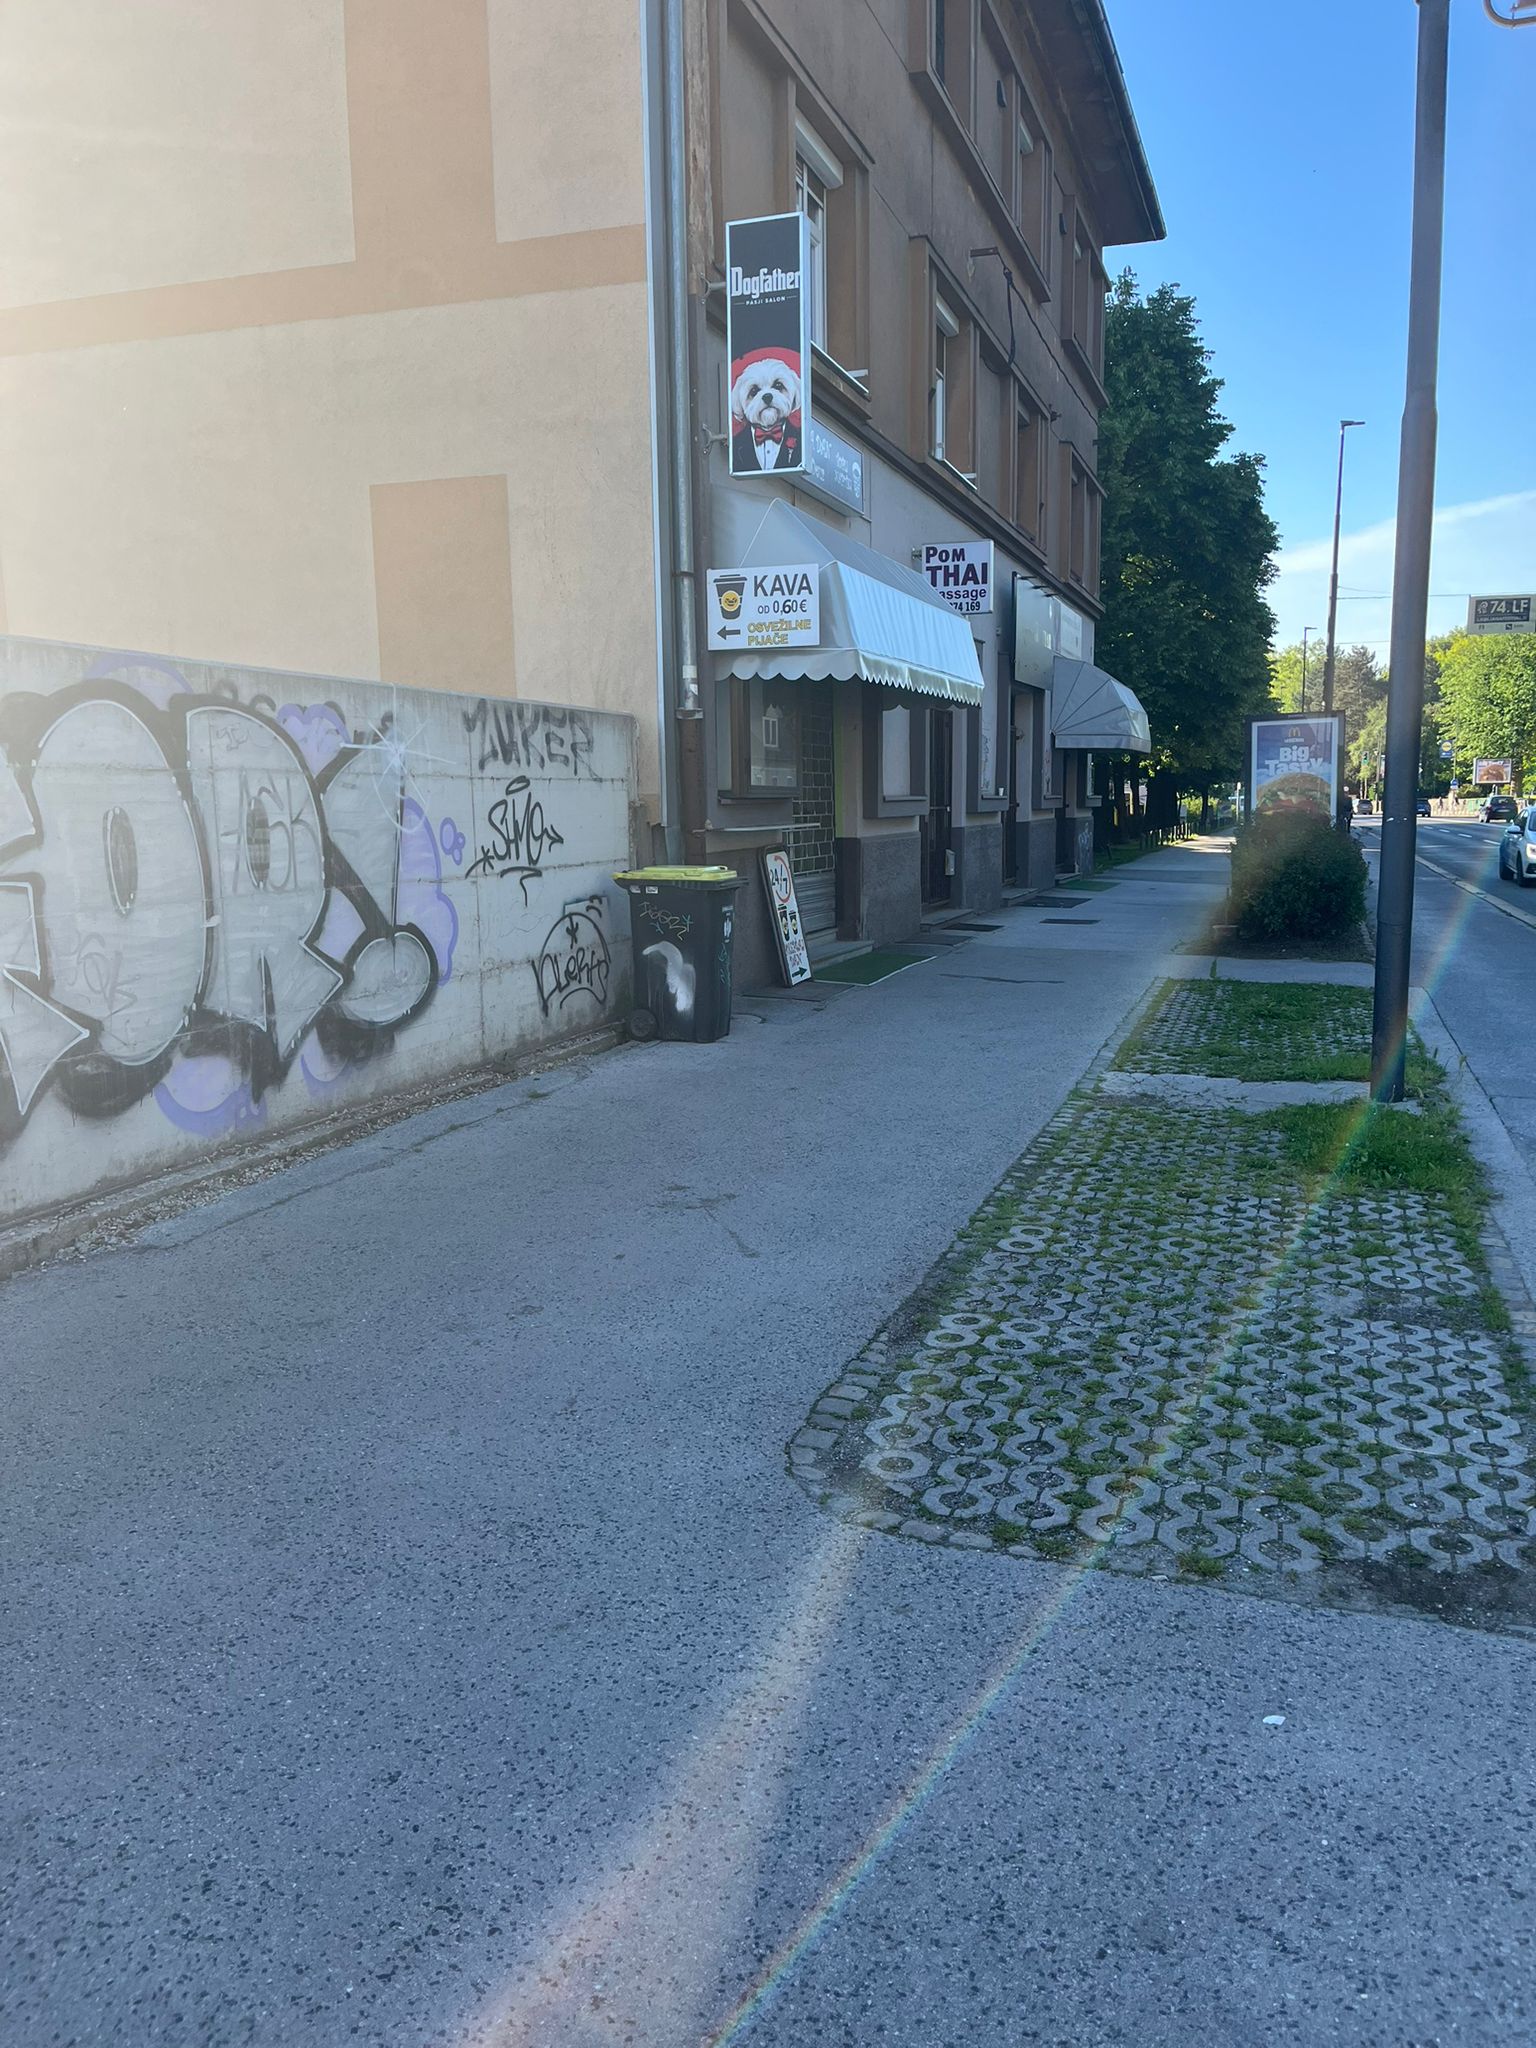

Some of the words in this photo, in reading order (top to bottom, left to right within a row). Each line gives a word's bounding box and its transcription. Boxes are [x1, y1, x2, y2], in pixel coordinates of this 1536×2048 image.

[731, 266, 801, 299] Dogfather
[765, 296, 786, 304] SALON
[925, 562, 988, 587] THAI
[753, 572, 813, 598] KAVA
[938, 588, 987, 601] assage
[949, 601, 964, 612] 74
[965, 601, 981, 612] 169
[747, 618, 812, 634] OSVEŽILNE
[747, 632, 789, 647] PIJAČE
[1279, 745, 1310, 762] Big
